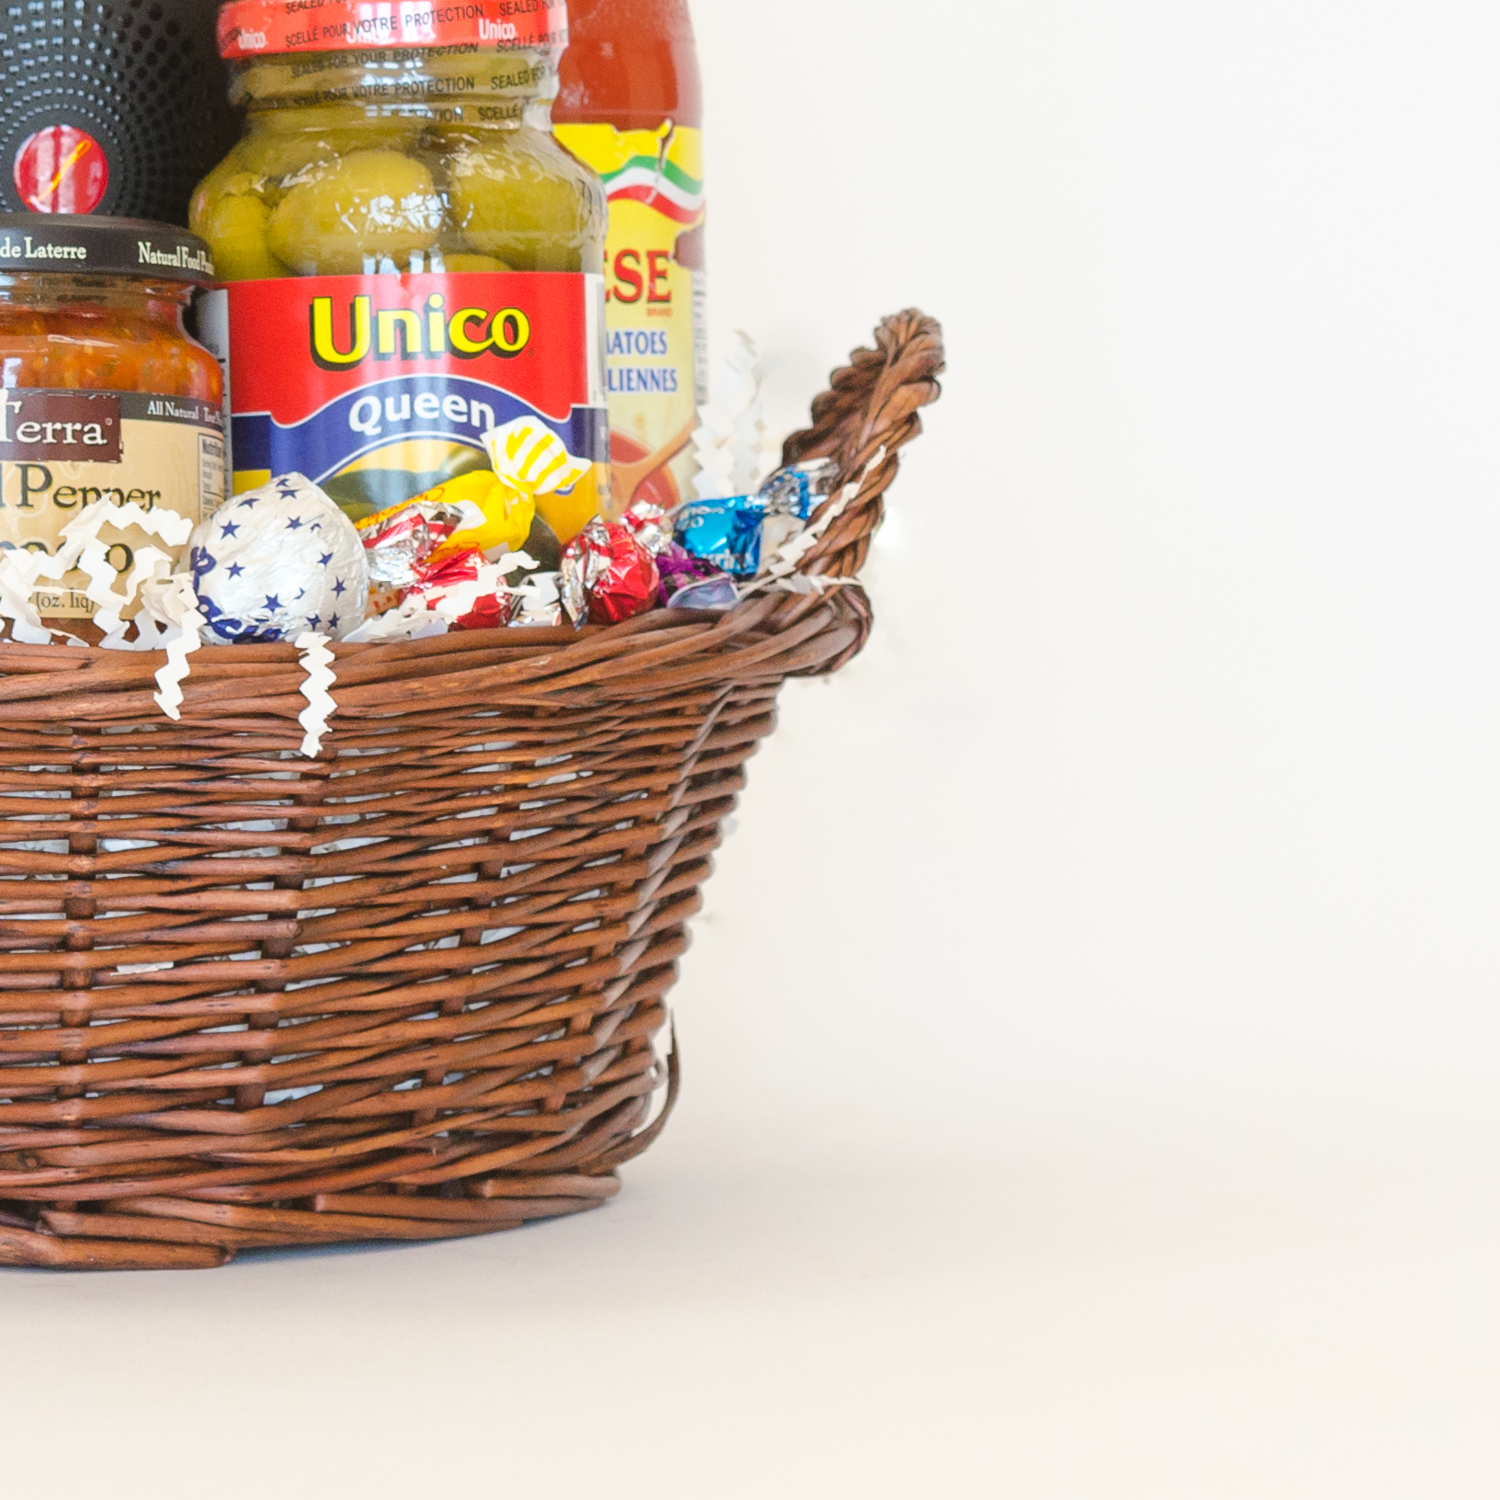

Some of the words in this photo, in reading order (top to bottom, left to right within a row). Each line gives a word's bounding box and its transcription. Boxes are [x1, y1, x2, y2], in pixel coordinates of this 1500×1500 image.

[286, 26, 318, 48] SCELLÉ
[353, 16, 398, 34] VOTRE
[405, 5, 484, 28] PROTECTION
[479, 18, 516, 41] Unico
[394, 76, 475, 96] PROTECTION
[2, 237, 22, 259] de
[24, 236, 87, 260] Laterre
[138, 240, 181, 268] Natural
[181, 245, 201, 272] Food
[604, 248, 673, 305] SE
[309, 292, 531, 372] Unico
[147, 400, 163, 416] All
[165, 401, 200, 421] Natural
[349, 392, 496, 435] Queen
